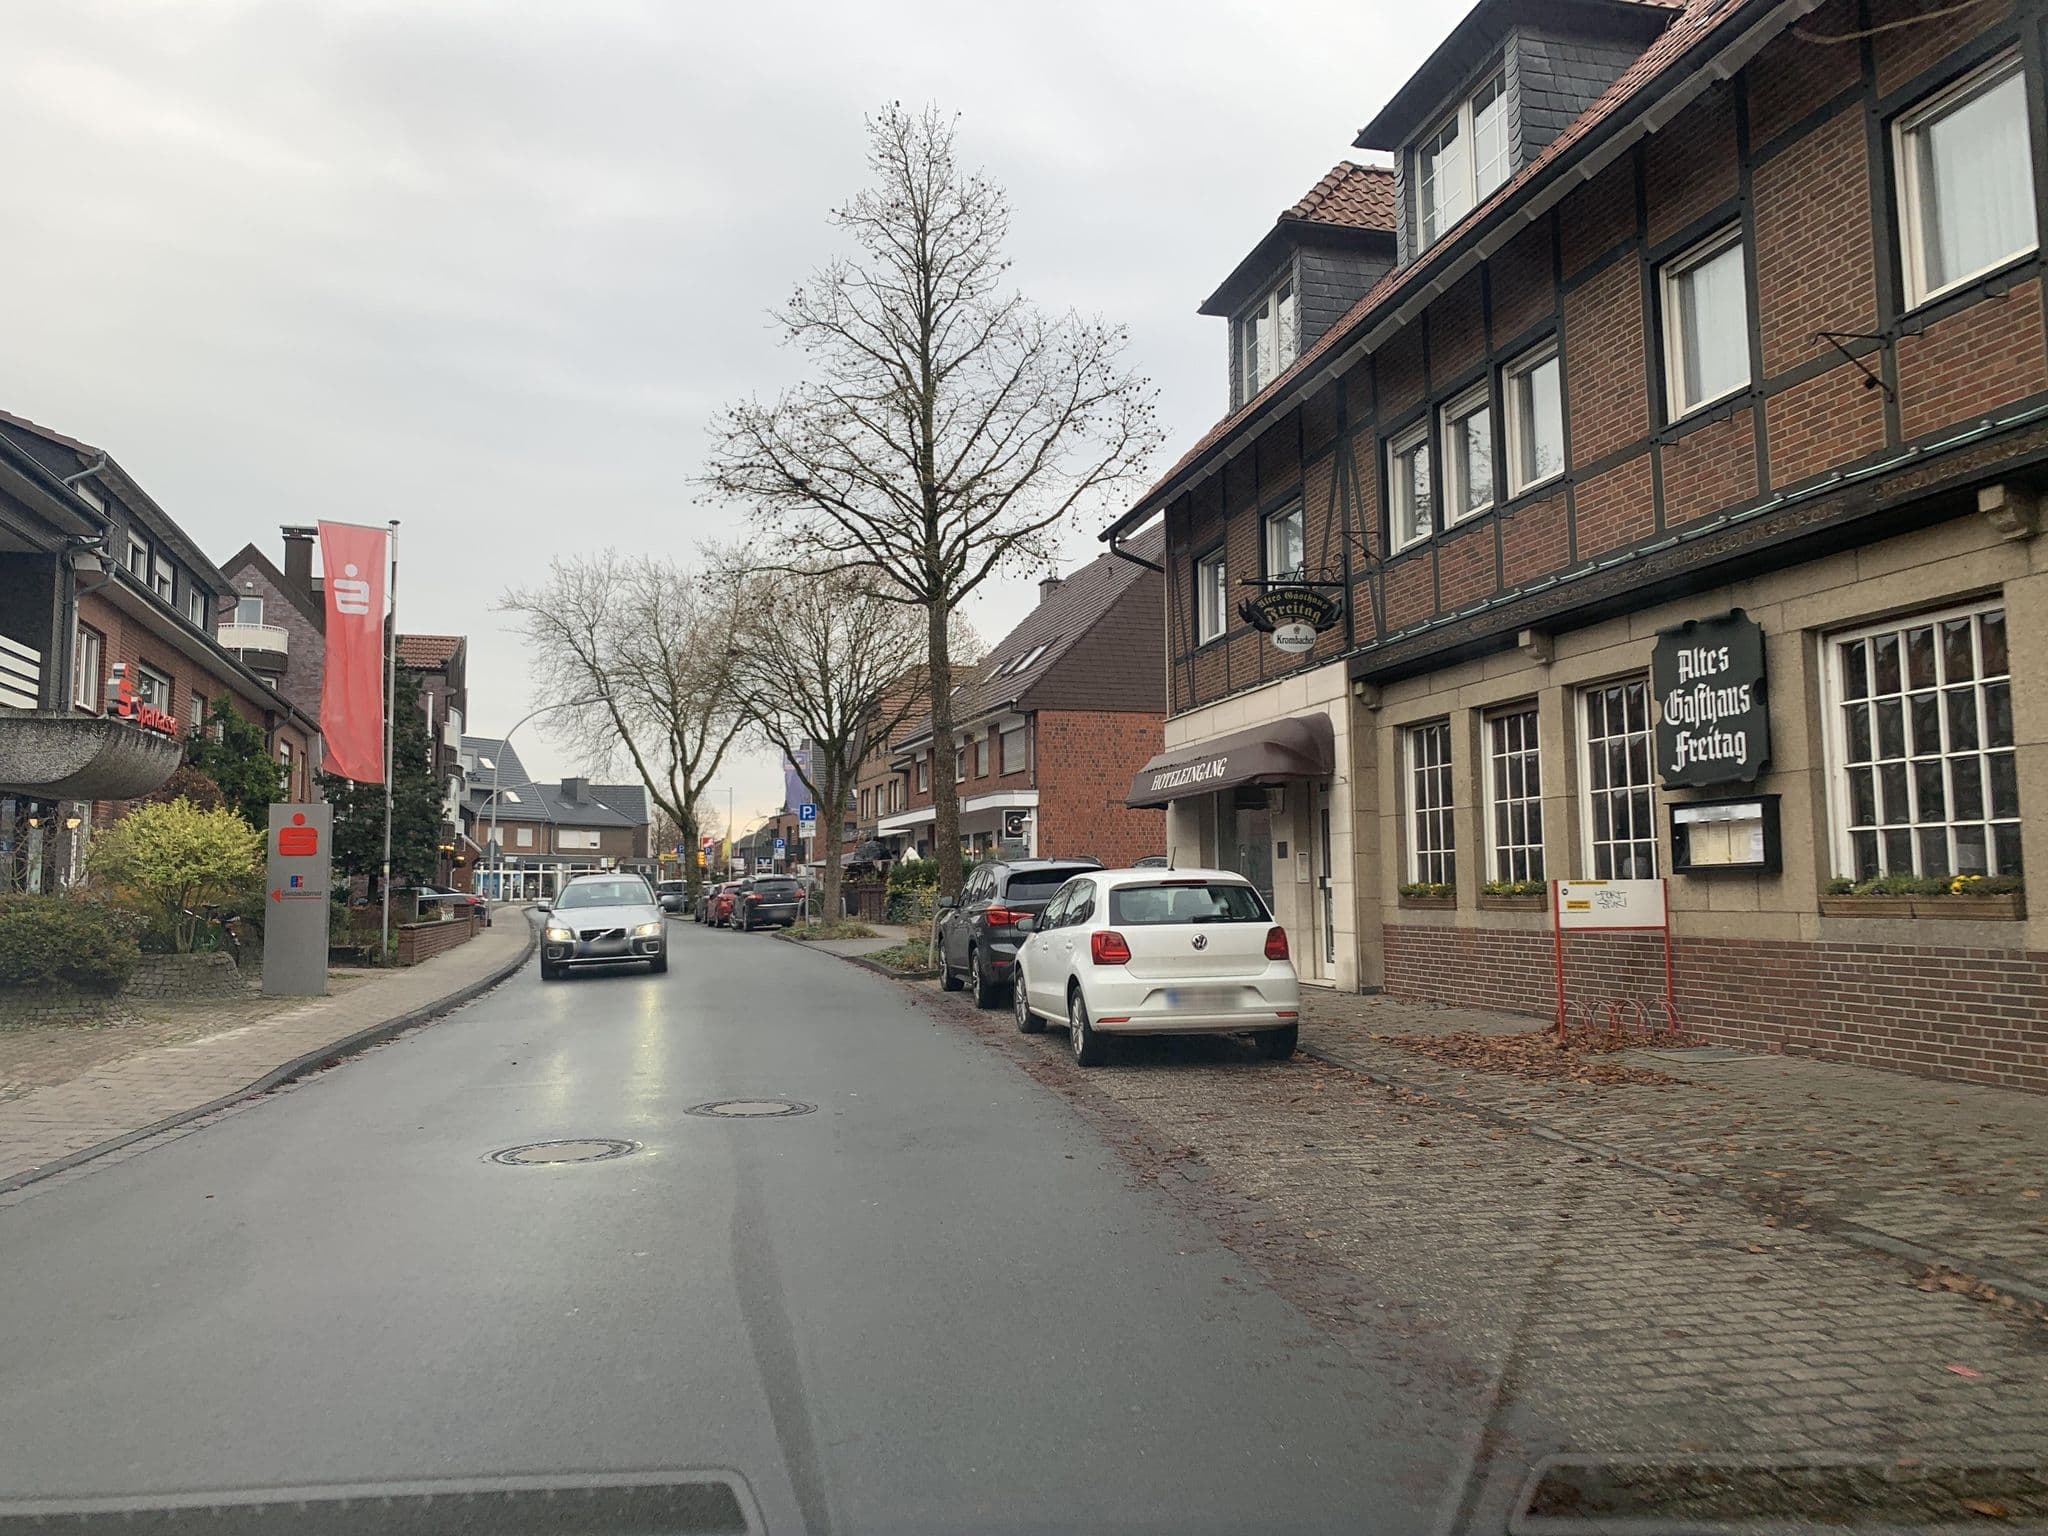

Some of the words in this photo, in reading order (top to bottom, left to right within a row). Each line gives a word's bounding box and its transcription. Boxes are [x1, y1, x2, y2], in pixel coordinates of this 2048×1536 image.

[1257, 594, 1281, 608] Altes
[1284, 590, 1329, 609] Gasthaus
[1263, 601, 1321, 625] Freitag
[1276, 633, 1316, 645] Krombacher
[1677, 646, 1730, 685] Altes
[136, 695, 178, 736] Sparkasse
[1670, 725, 1748, 773] Freitag
[1150, 757, 1228, 791] HOTELEINGANG
